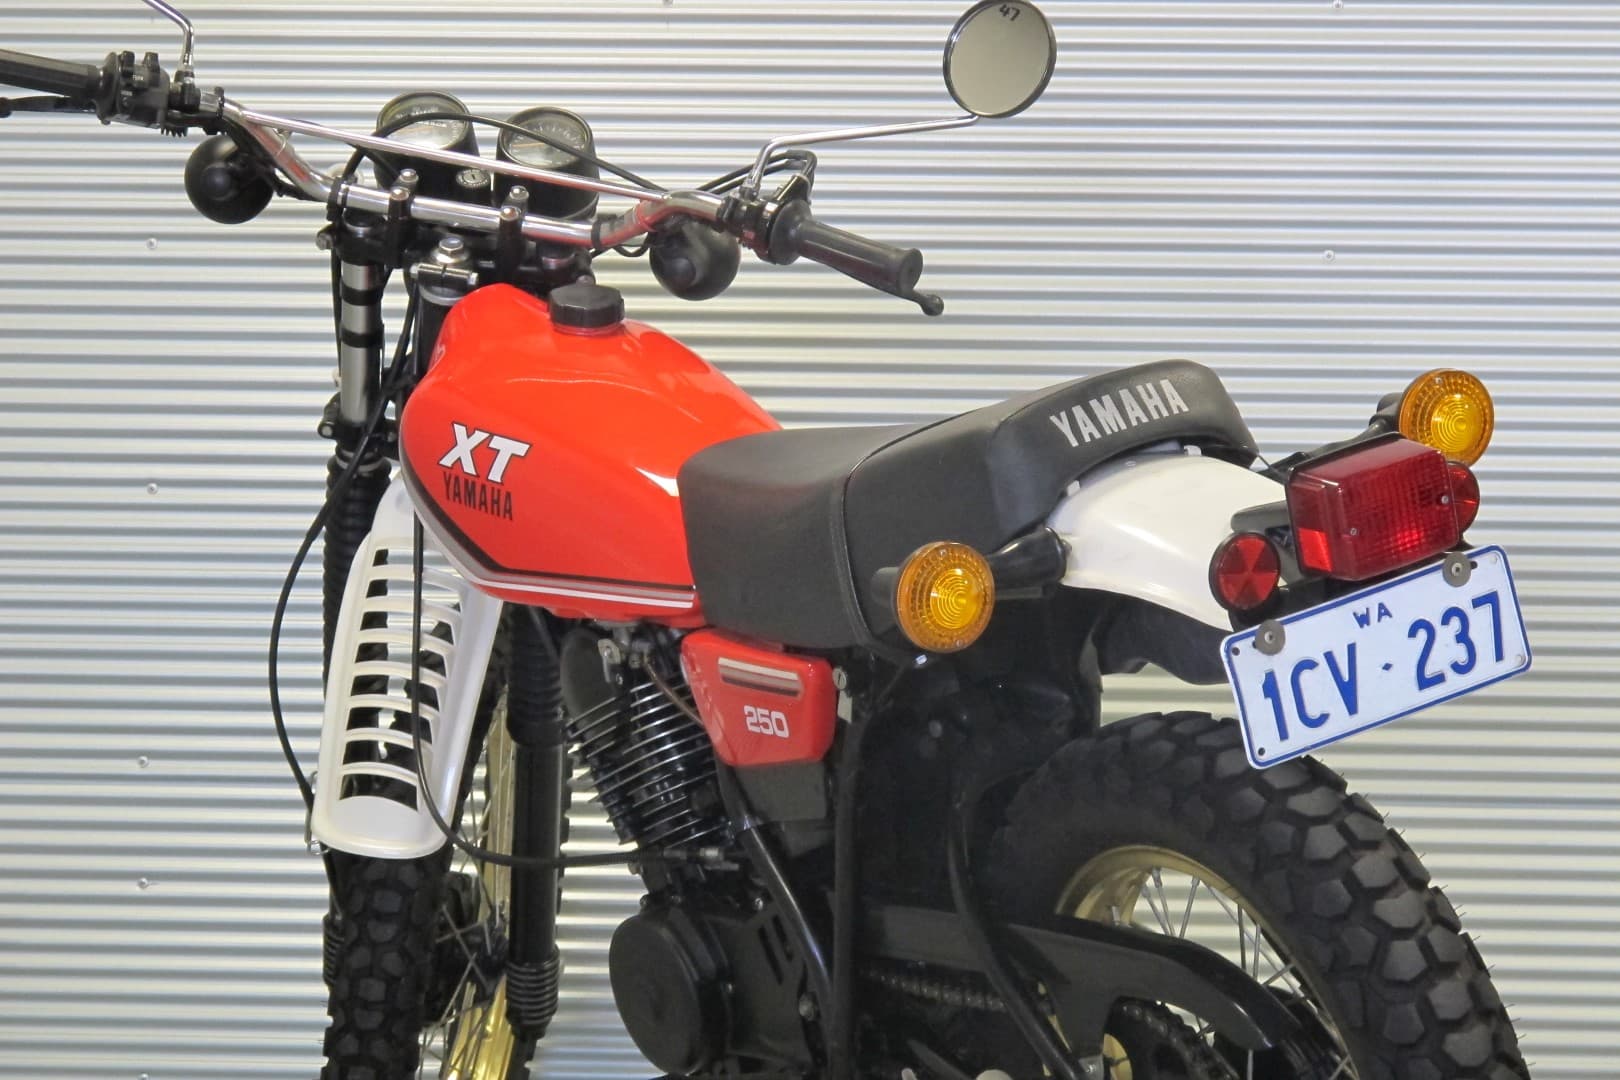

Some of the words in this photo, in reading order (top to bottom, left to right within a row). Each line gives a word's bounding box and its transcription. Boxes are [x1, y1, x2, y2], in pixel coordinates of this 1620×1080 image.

[999, 4, 1020, 21] 47
[1050, 379, 1189, 447] YAMAHA
[437, 421, 533, 485] XT
[443, 471, 513, 521] YAMAHA
[1353, 602, 1393, 628] WA
[743, 705, 789, 738] 250
